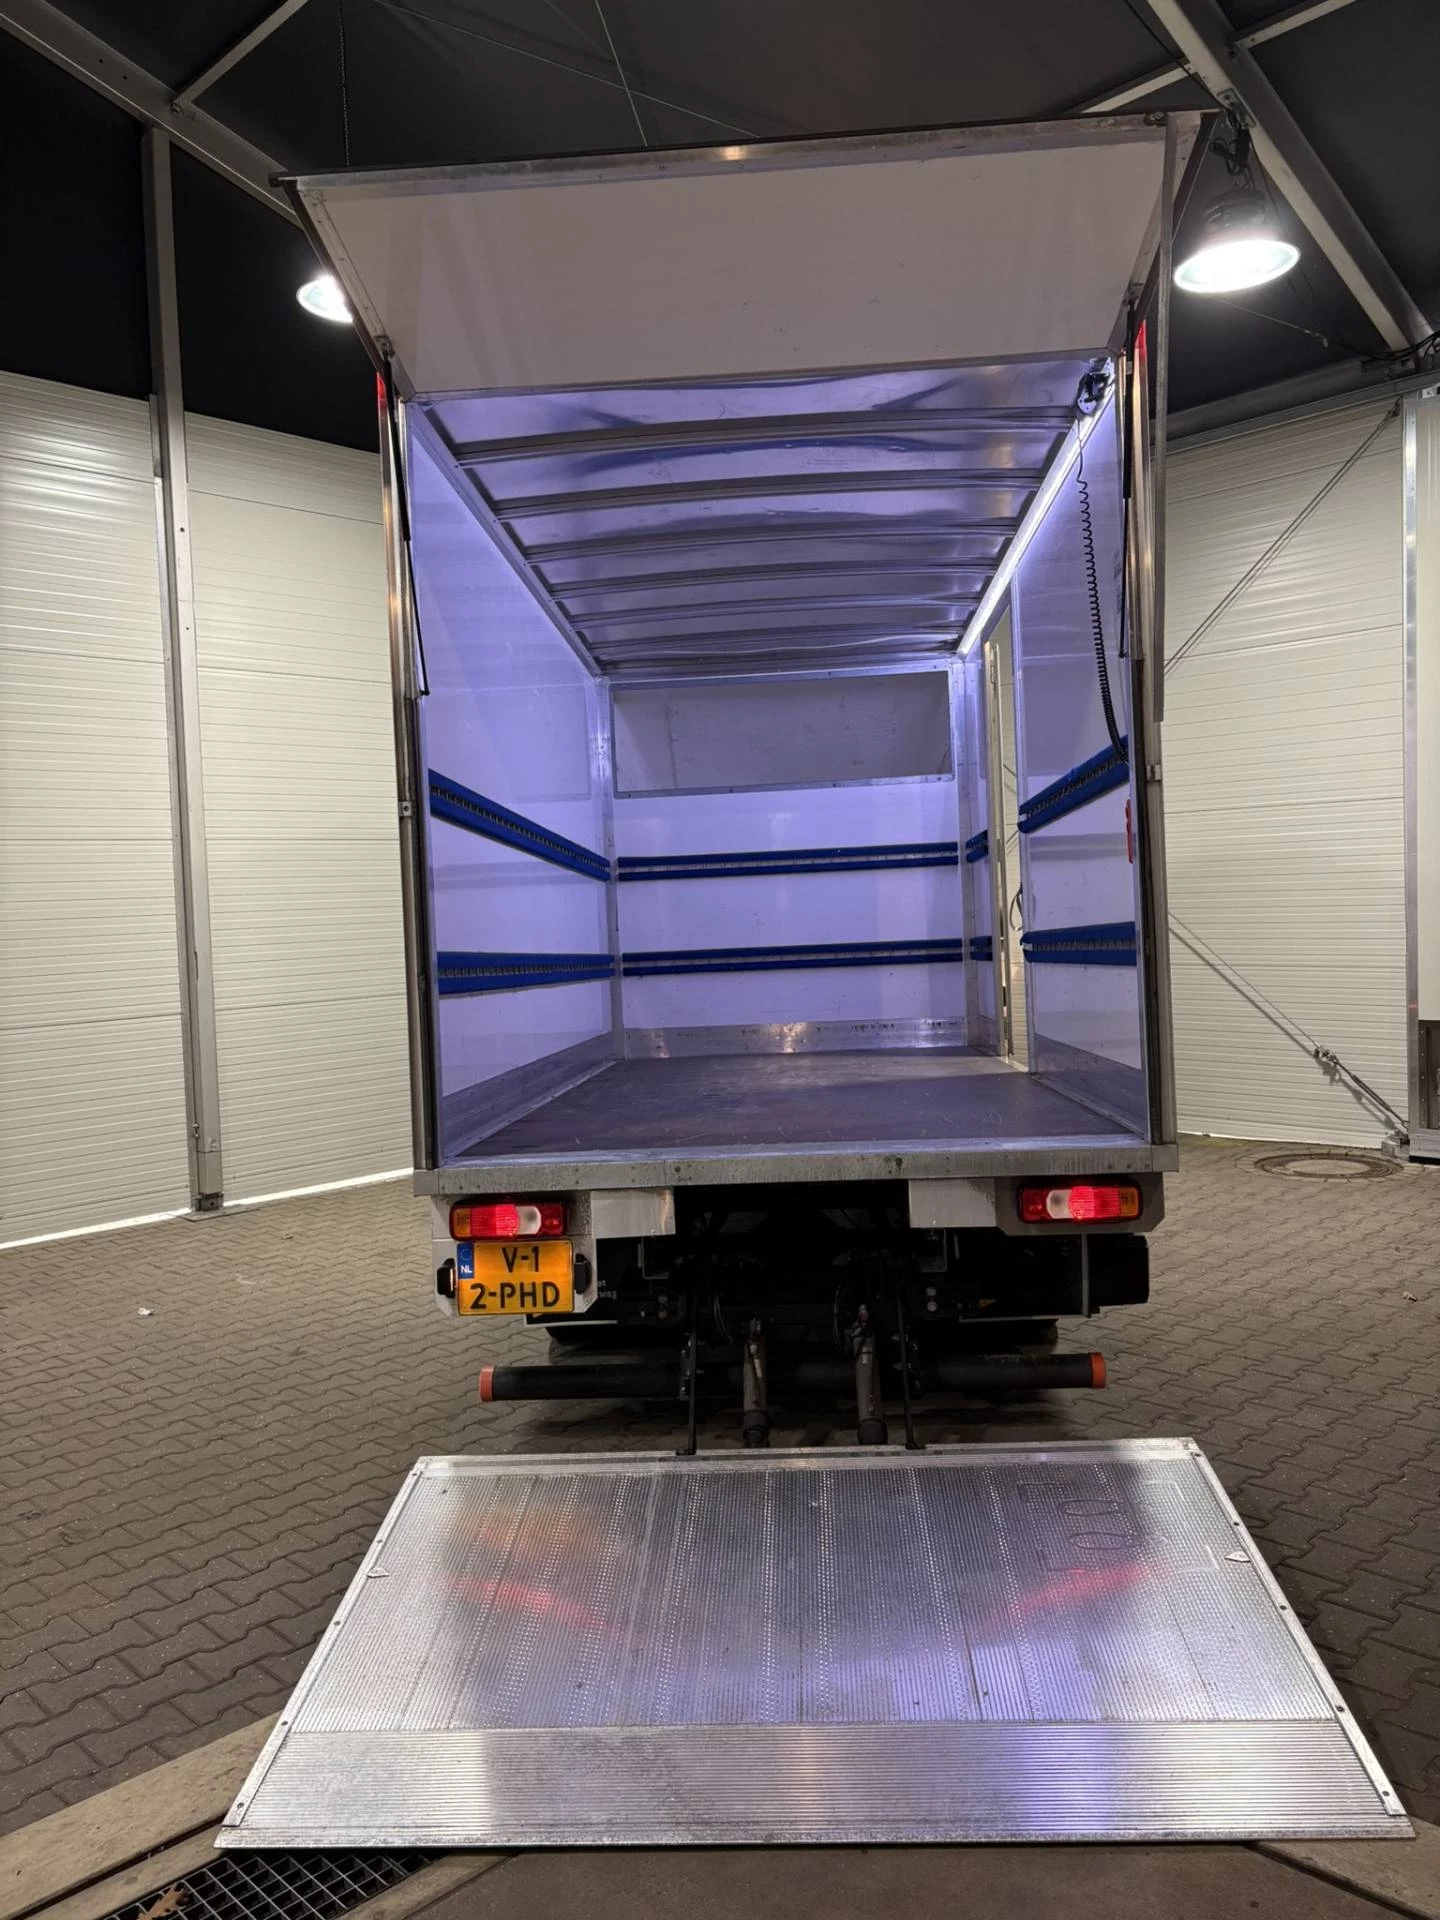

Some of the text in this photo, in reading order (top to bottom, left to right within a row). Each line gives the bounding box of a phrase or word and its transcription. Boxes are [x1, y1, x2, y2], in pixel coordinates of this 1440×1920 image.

[460, 1265, 473, 1274] NL
[501, 1246, 540, 1273] V-1
[470, 1281, 560, 1310] 2-PHD
